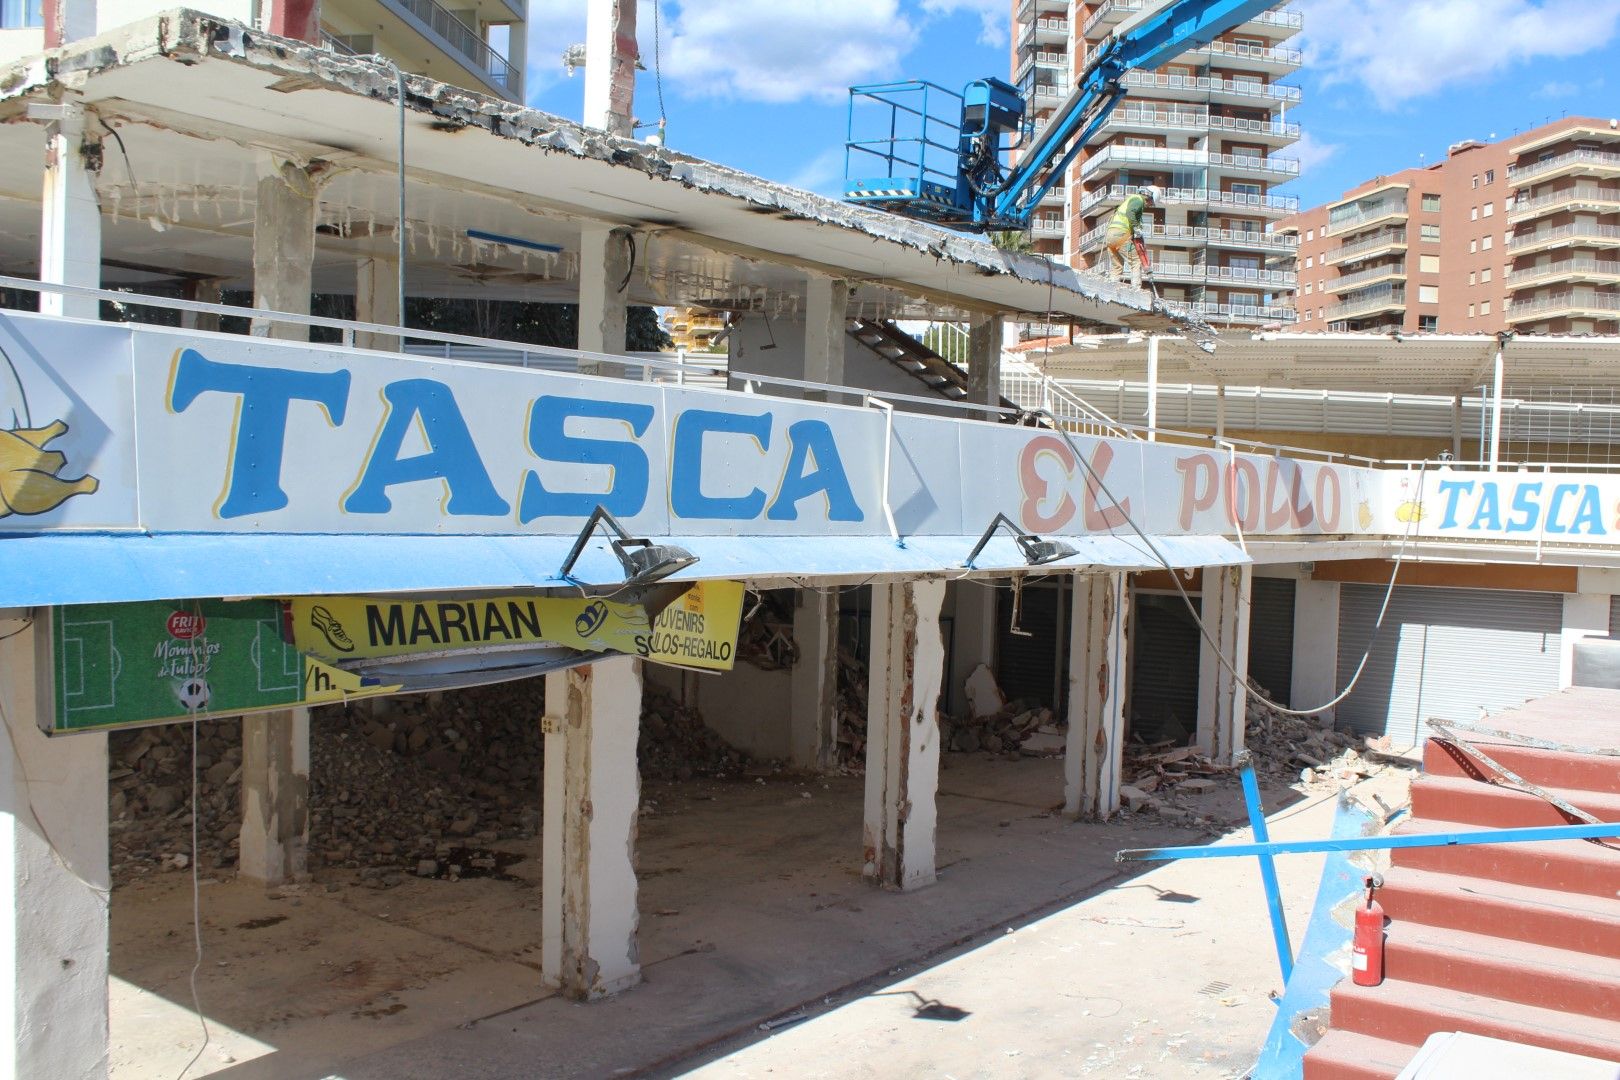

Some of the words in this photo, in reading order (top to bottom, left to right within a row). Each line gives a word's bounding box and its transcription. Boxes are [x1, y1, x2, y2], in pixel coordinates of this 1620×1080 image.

[165, 348, 864, 525] TASCA
[1018, 435, 1131, 534] EL
[1175, 453, 1341, 534] POLLO
[1438, 480, 1607, 535] TASCA
[366, 601, 532, 647] MARIAN
